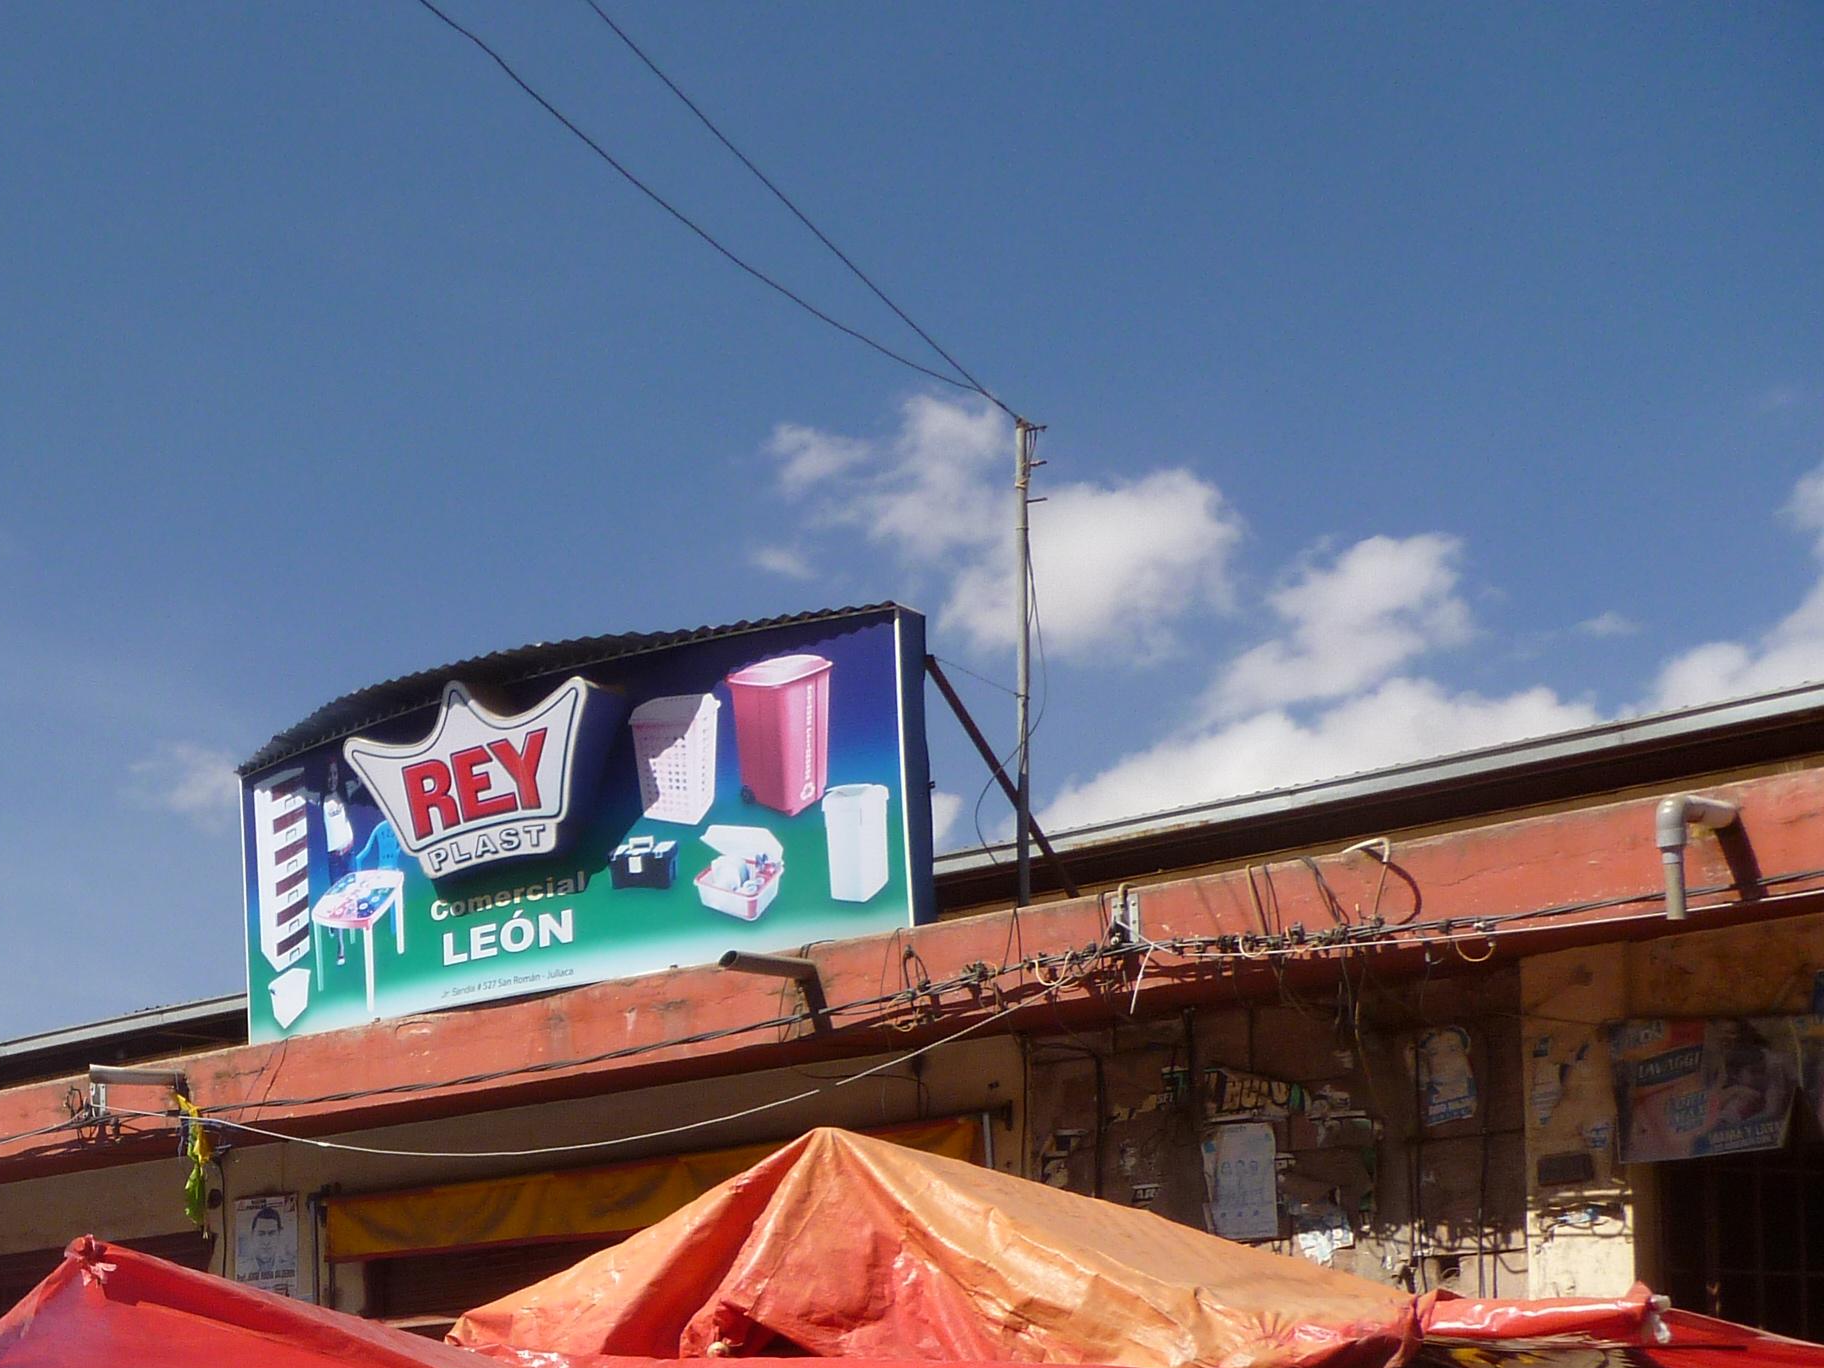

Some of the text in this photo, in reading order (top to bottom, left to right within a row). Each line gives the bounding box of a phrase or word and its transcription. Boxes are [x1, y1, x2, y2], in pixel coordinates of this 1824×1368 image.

[402, 727, 548, 841] REY
[427, 824, 546, 873] PLAST
[430, 870, 586, 921] Comercial
[442, 908, 574, 967] LEÓN
[482, 979, 497, 991] 527
[497, 977, 512, 988] San
[512, 971, 541, 985] Román
